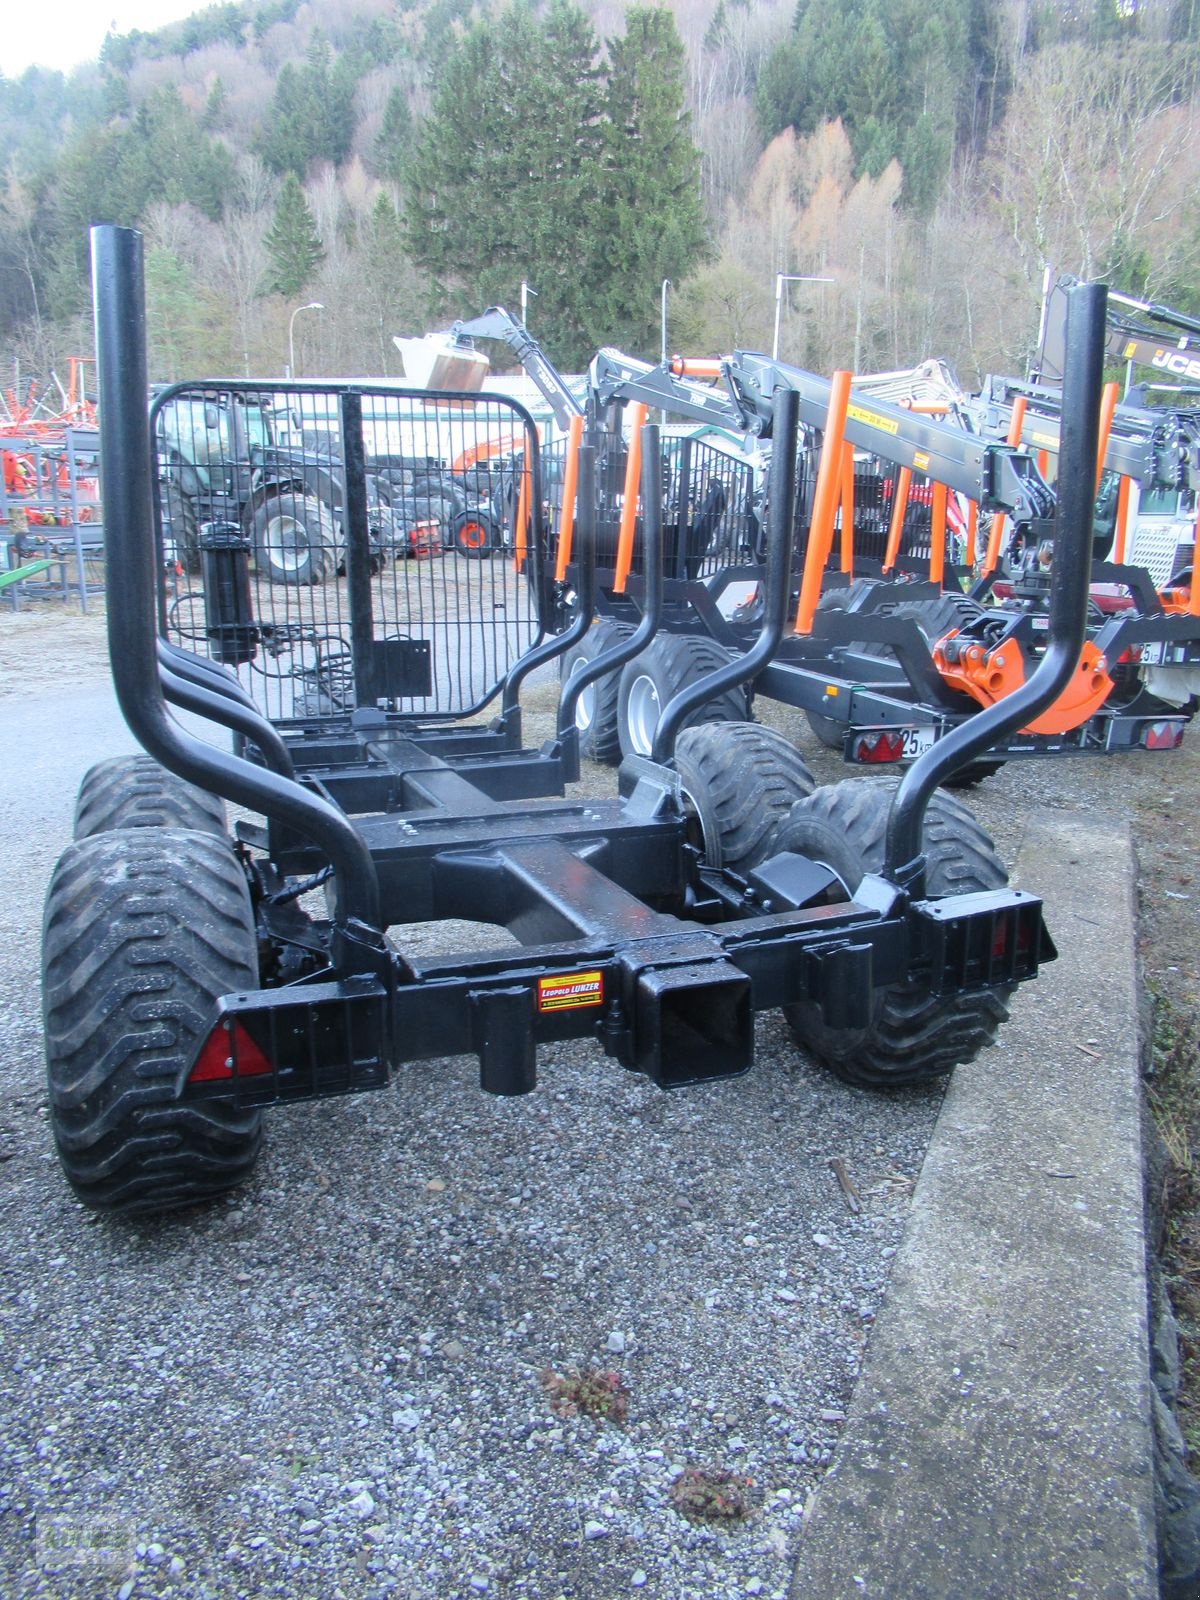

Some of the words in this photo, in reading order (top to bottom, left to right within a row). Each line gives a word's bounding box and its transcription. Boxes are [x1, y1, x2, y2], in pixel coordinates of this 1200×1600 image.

[1151, 350, 1200, 380] JCB
[901, 729, 920, 755] 25
[542, 988, 570, 996] LEOPOLD
[571, 982, 600, 993] LUNZER
